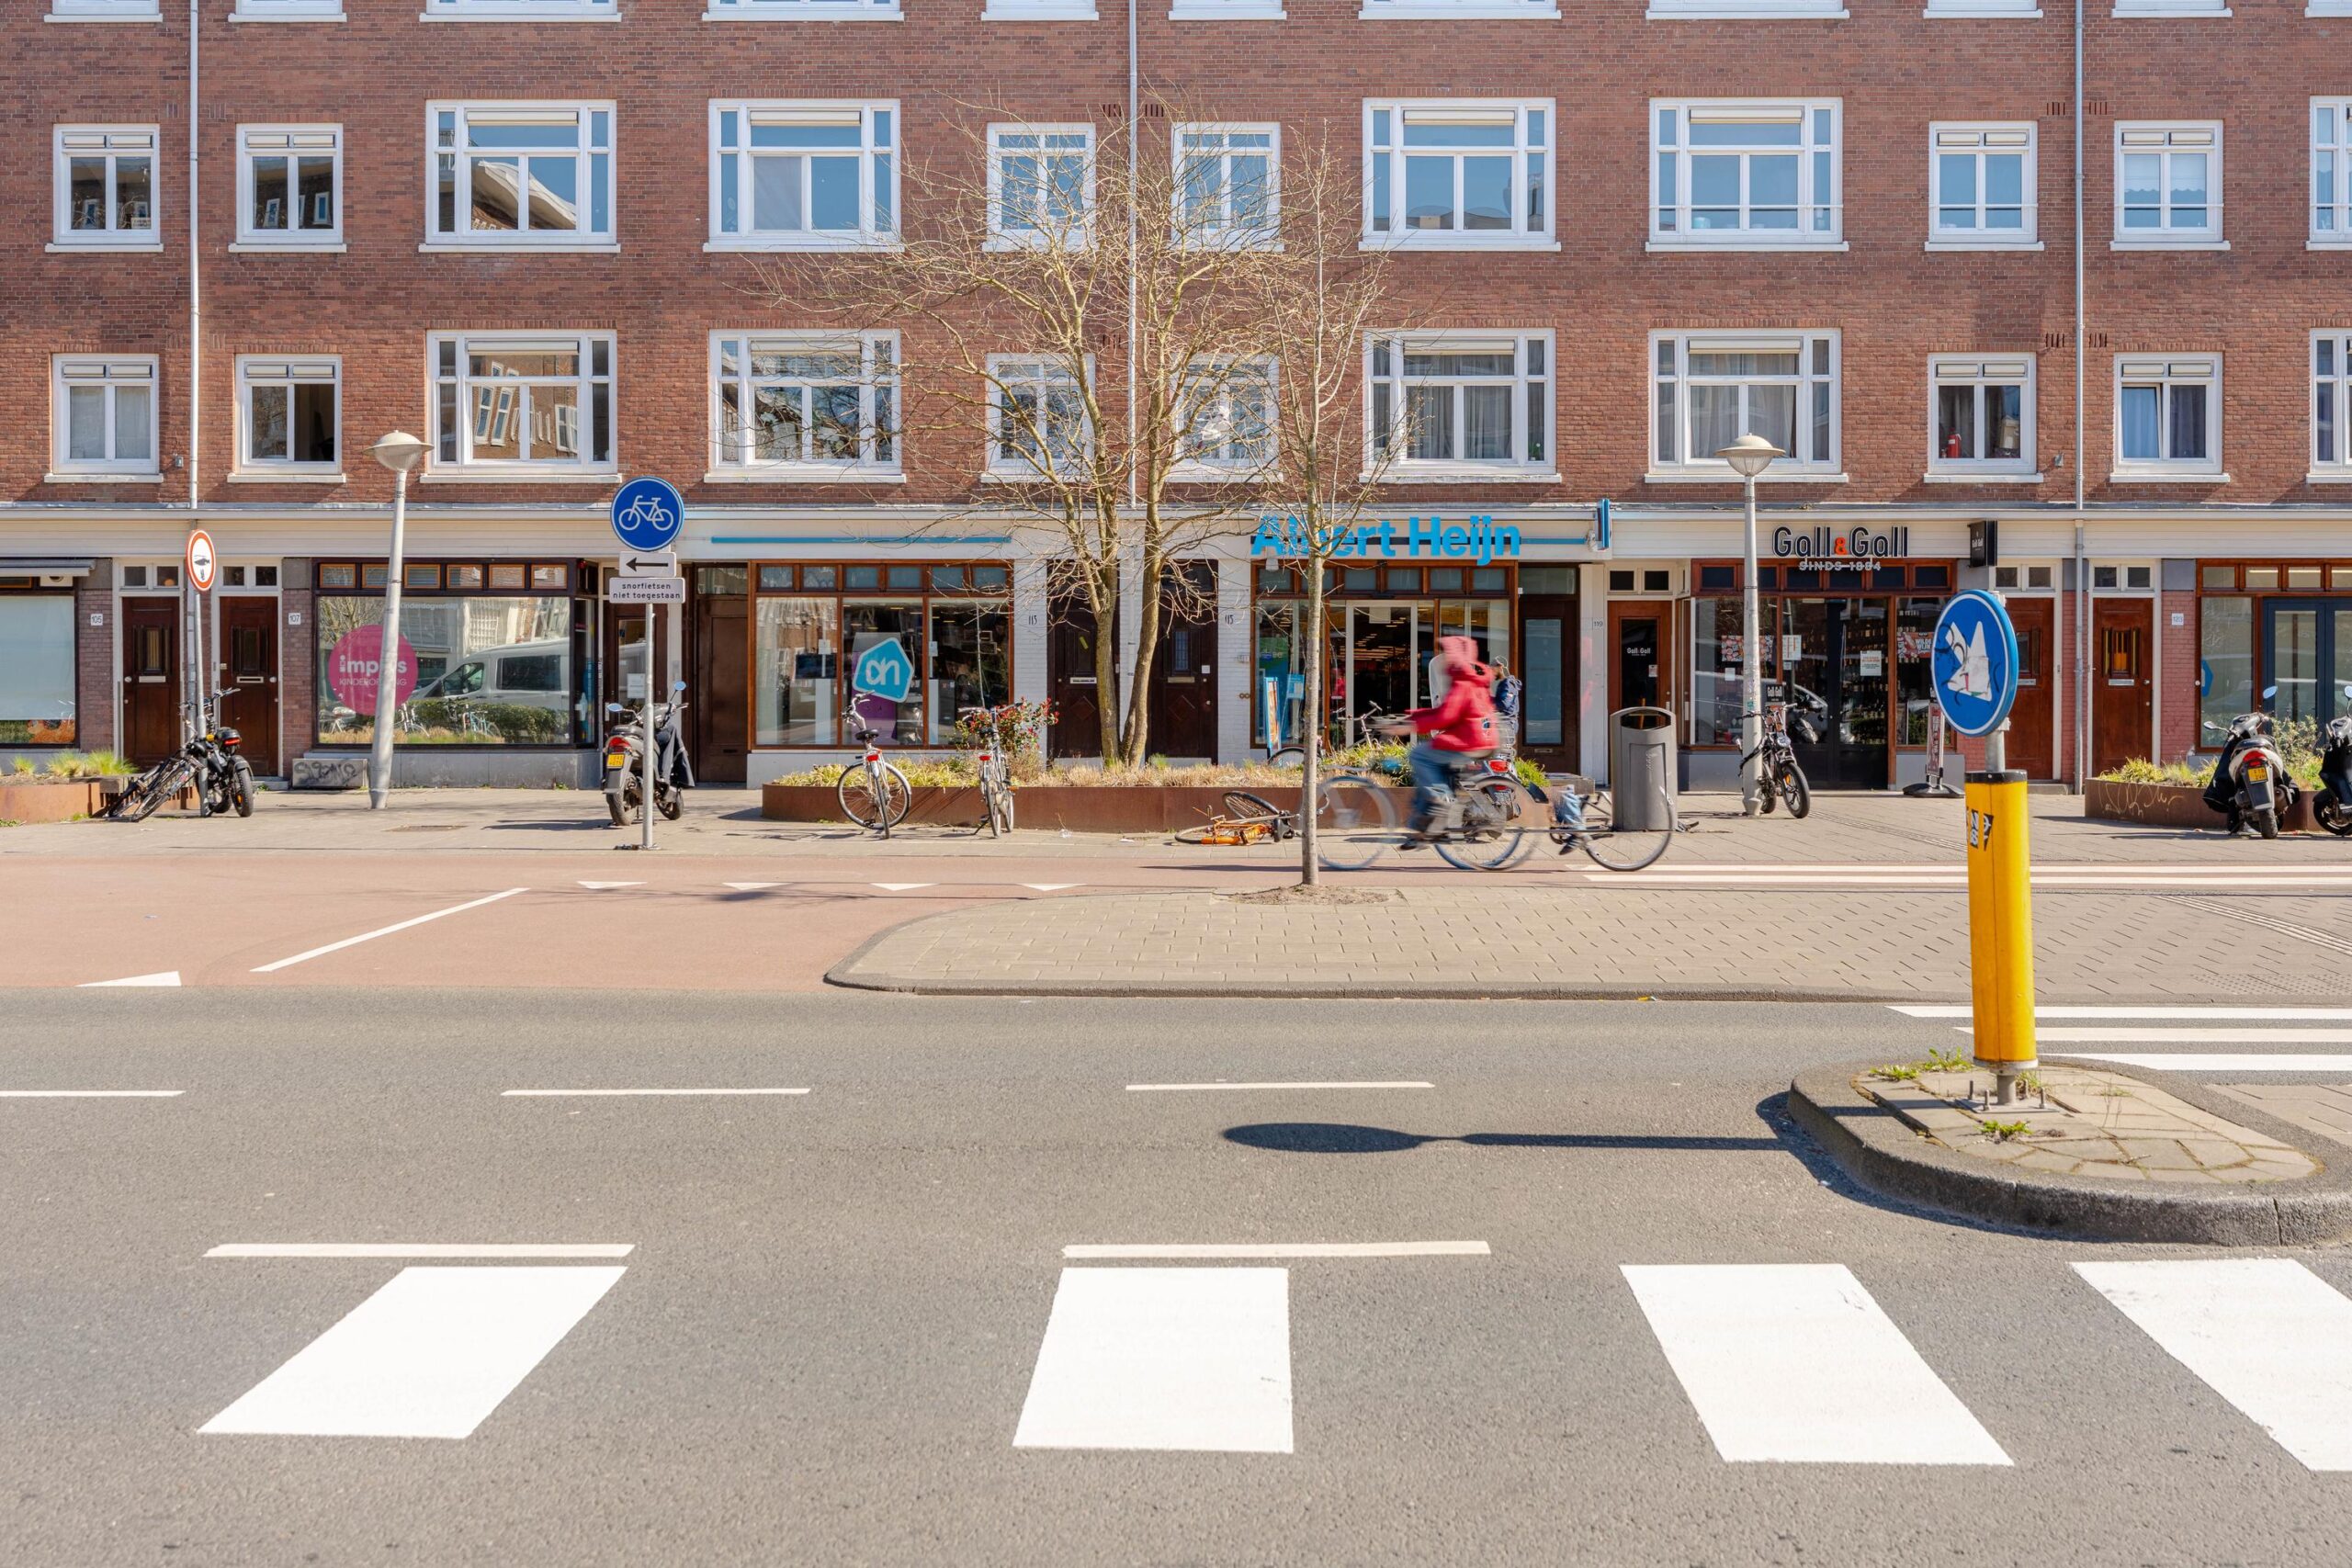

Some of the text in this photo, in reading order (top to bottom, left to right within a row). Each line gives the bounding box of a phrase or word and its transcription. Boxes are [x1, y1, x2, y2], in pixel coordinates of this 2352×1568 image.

[1250, 514, 1521, 566] Albert Heijn
[1798, 560, 1843, 571] SINDS
[339, 655, 407, 676] imps
